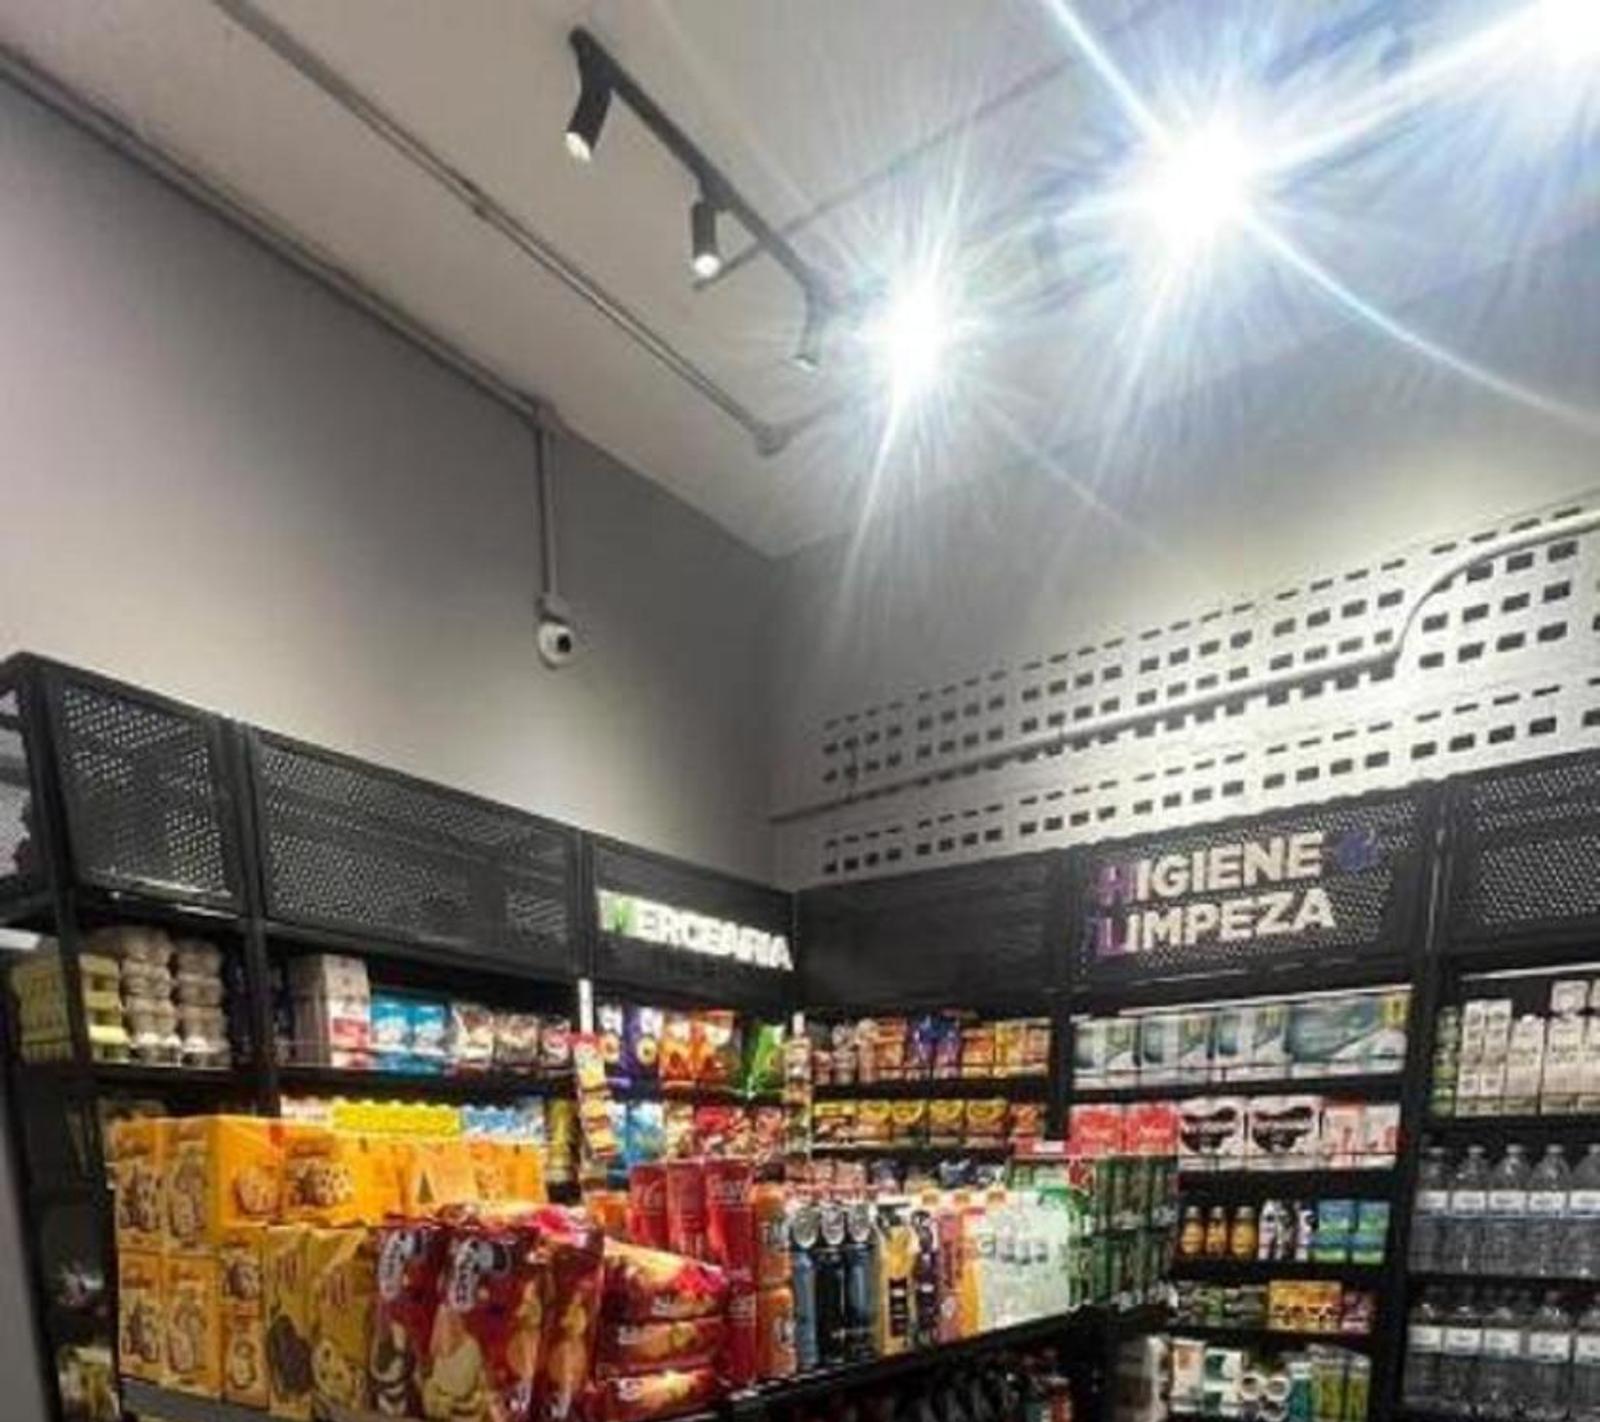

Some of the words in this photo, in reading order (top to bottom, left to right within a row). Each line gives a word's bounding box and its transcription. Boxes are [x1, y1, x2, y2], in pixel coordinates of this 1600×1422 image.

[1097, 831, 1325, 904] HIGIENE
[598, 890, 794, 970] MERCEARIA
[1096, 888, 1336, 955] LIMPEZA
